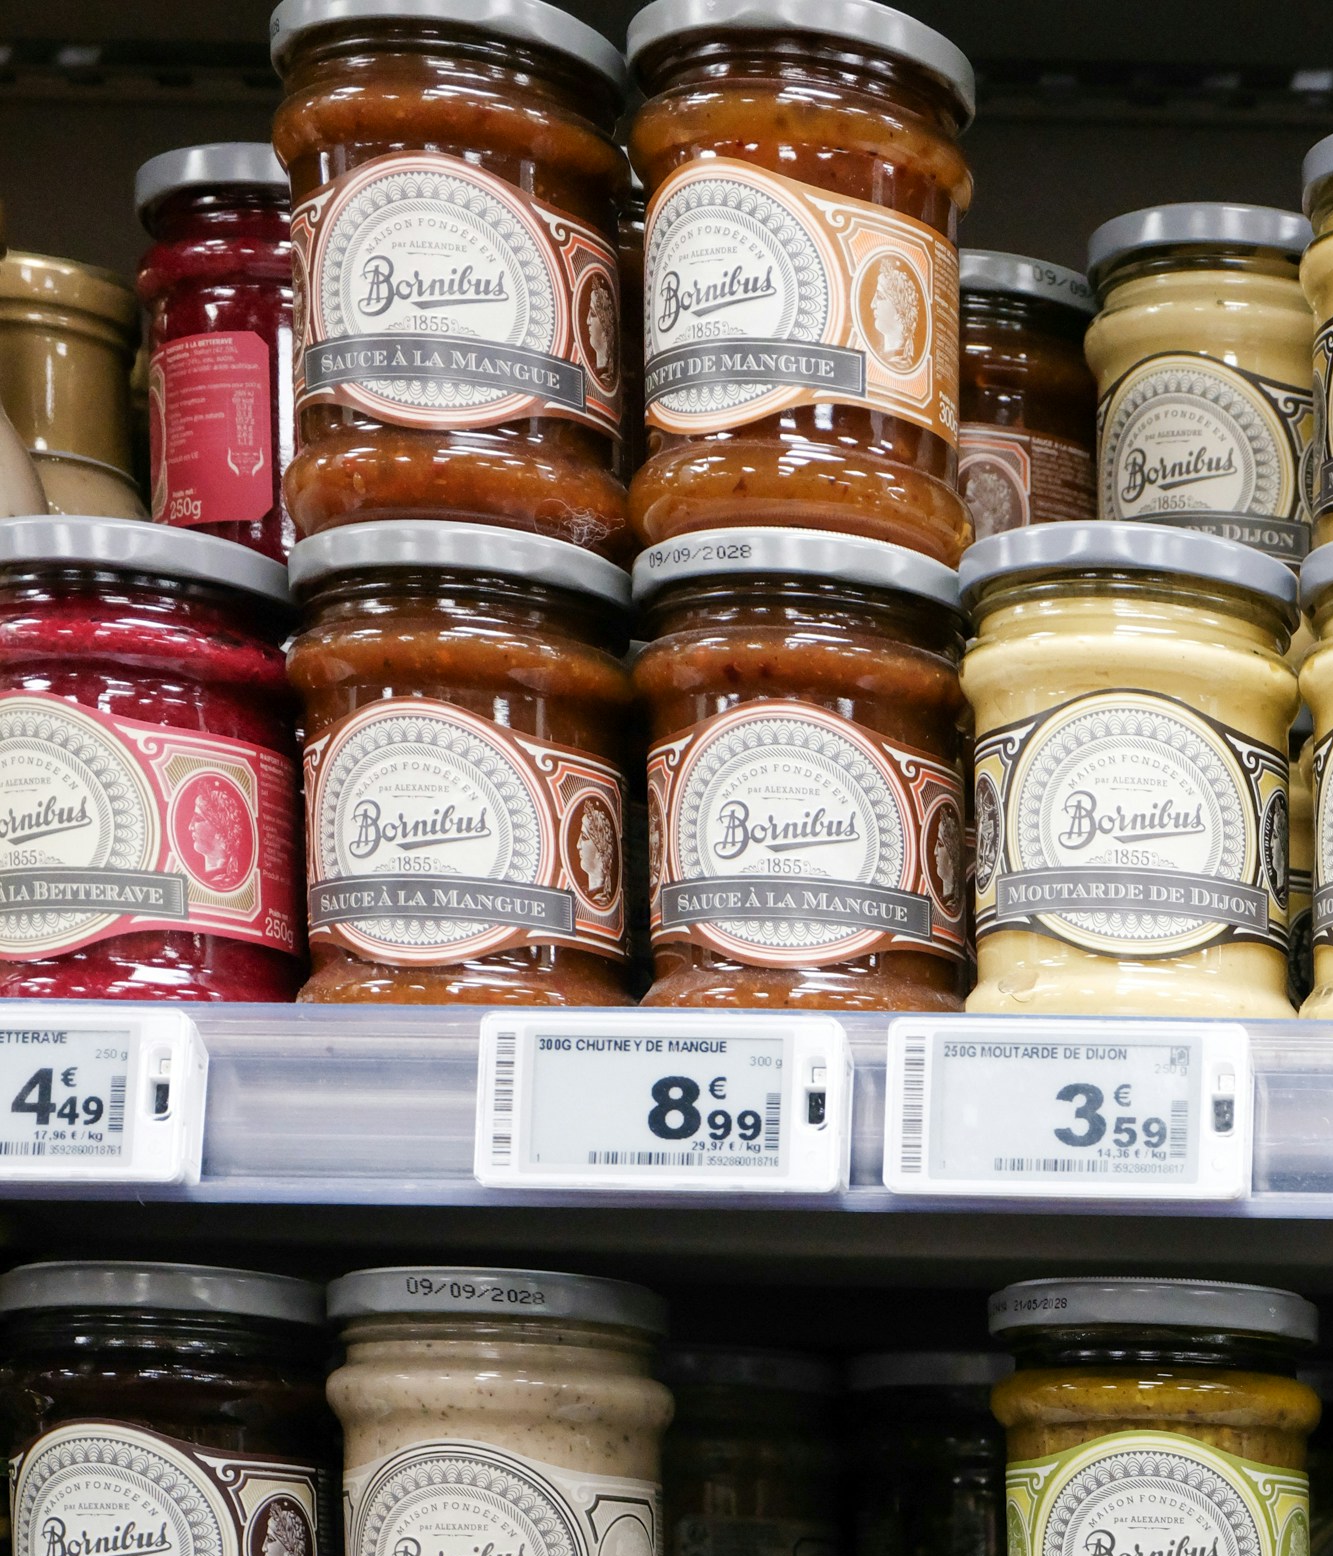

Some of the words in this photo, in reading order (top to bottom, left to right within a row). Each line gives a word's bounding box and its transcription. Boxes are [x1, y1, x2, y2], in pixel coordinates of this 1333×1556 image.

[358, 255, 508, 316] Bornibus
[412, 316, 449, 333] 1855
[321, 351, 386, 374] SAUCE
[392, 348, 407, 368] À
[415, 349, 442, 369] LA
[450, 351, 559, 390] MANGUE
[648, 544, 752, 568] 09/09/2028
[1008, 882, 1141, 906] MOUTARDE
[1148, 886, 1183, 903] DE
[1189, 886, 1258, 916] DIJON
[647, 1041, 663, 1053] DE
[668, 1041, 727, 1053] MANGUE
